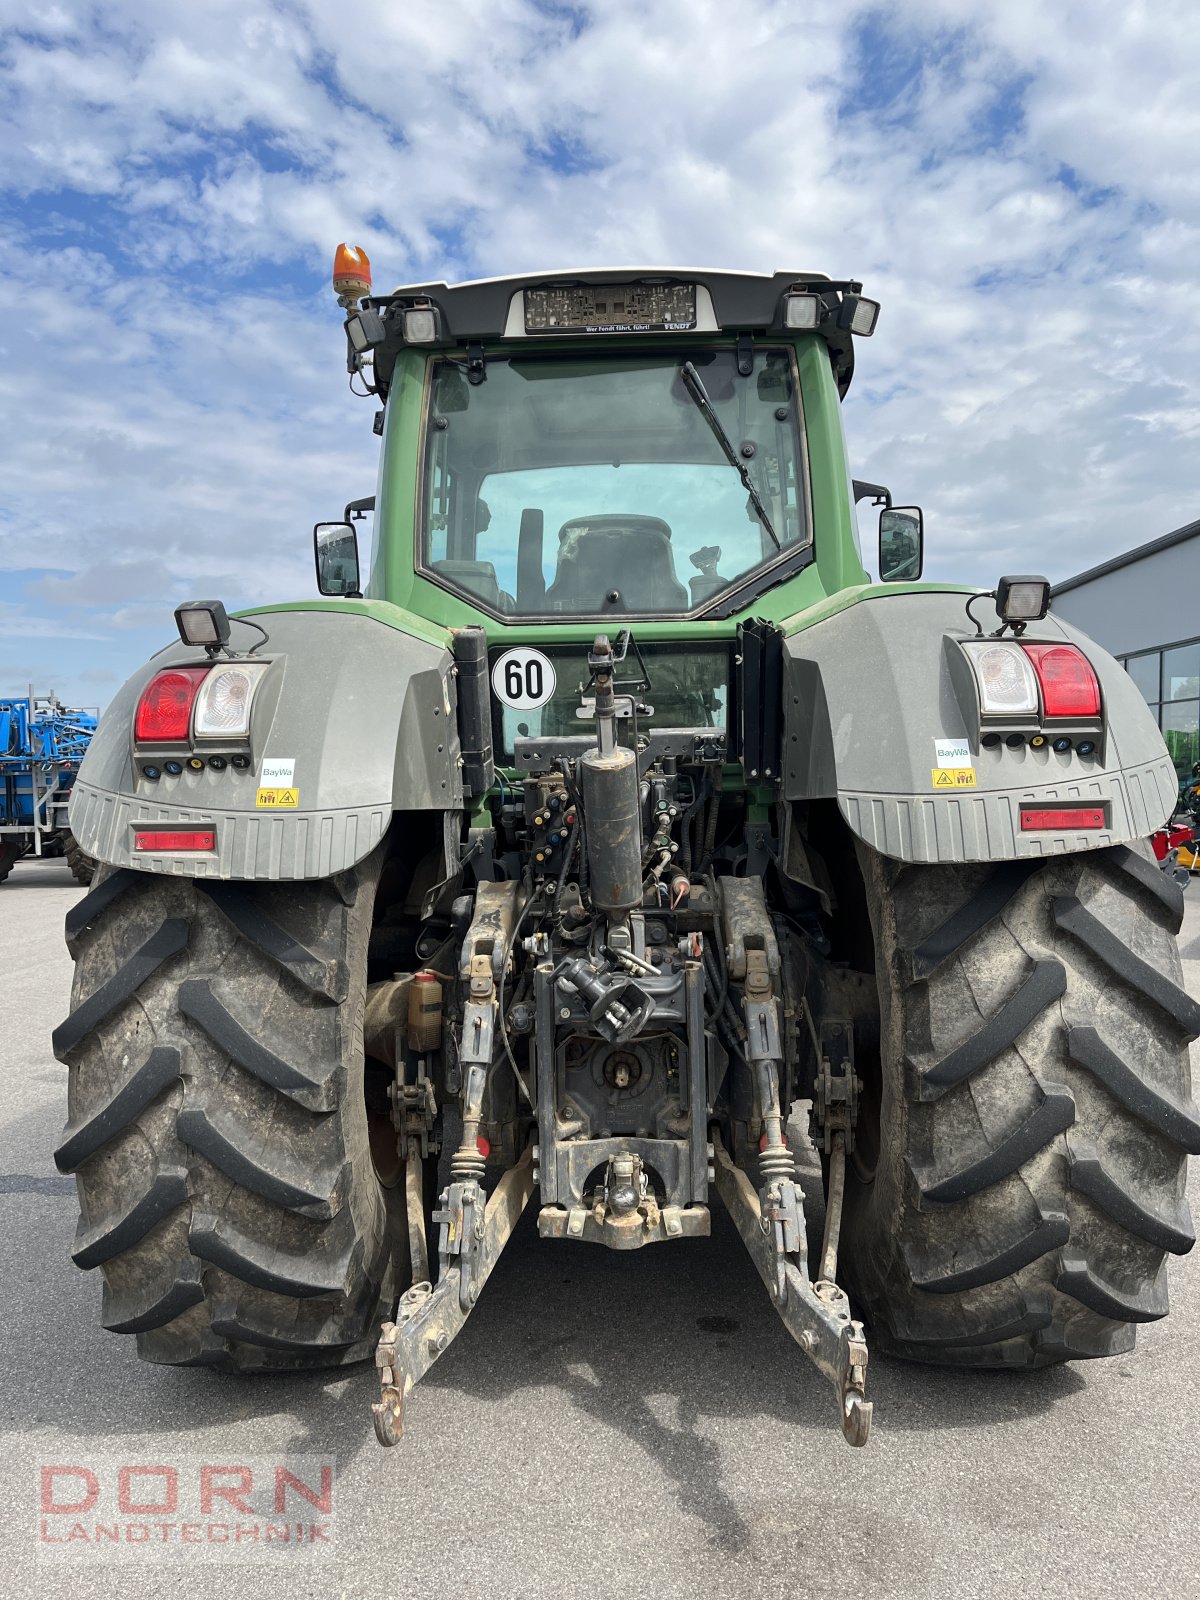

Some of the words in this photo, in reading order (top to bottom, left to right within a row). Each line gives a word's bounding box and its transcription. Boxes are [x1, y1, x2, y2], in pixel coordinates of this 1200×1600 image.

[505, 659, 543, 699] 60
[937, 748, 969, 757] BayWa
[262, 768, 292, 777] BayWa
